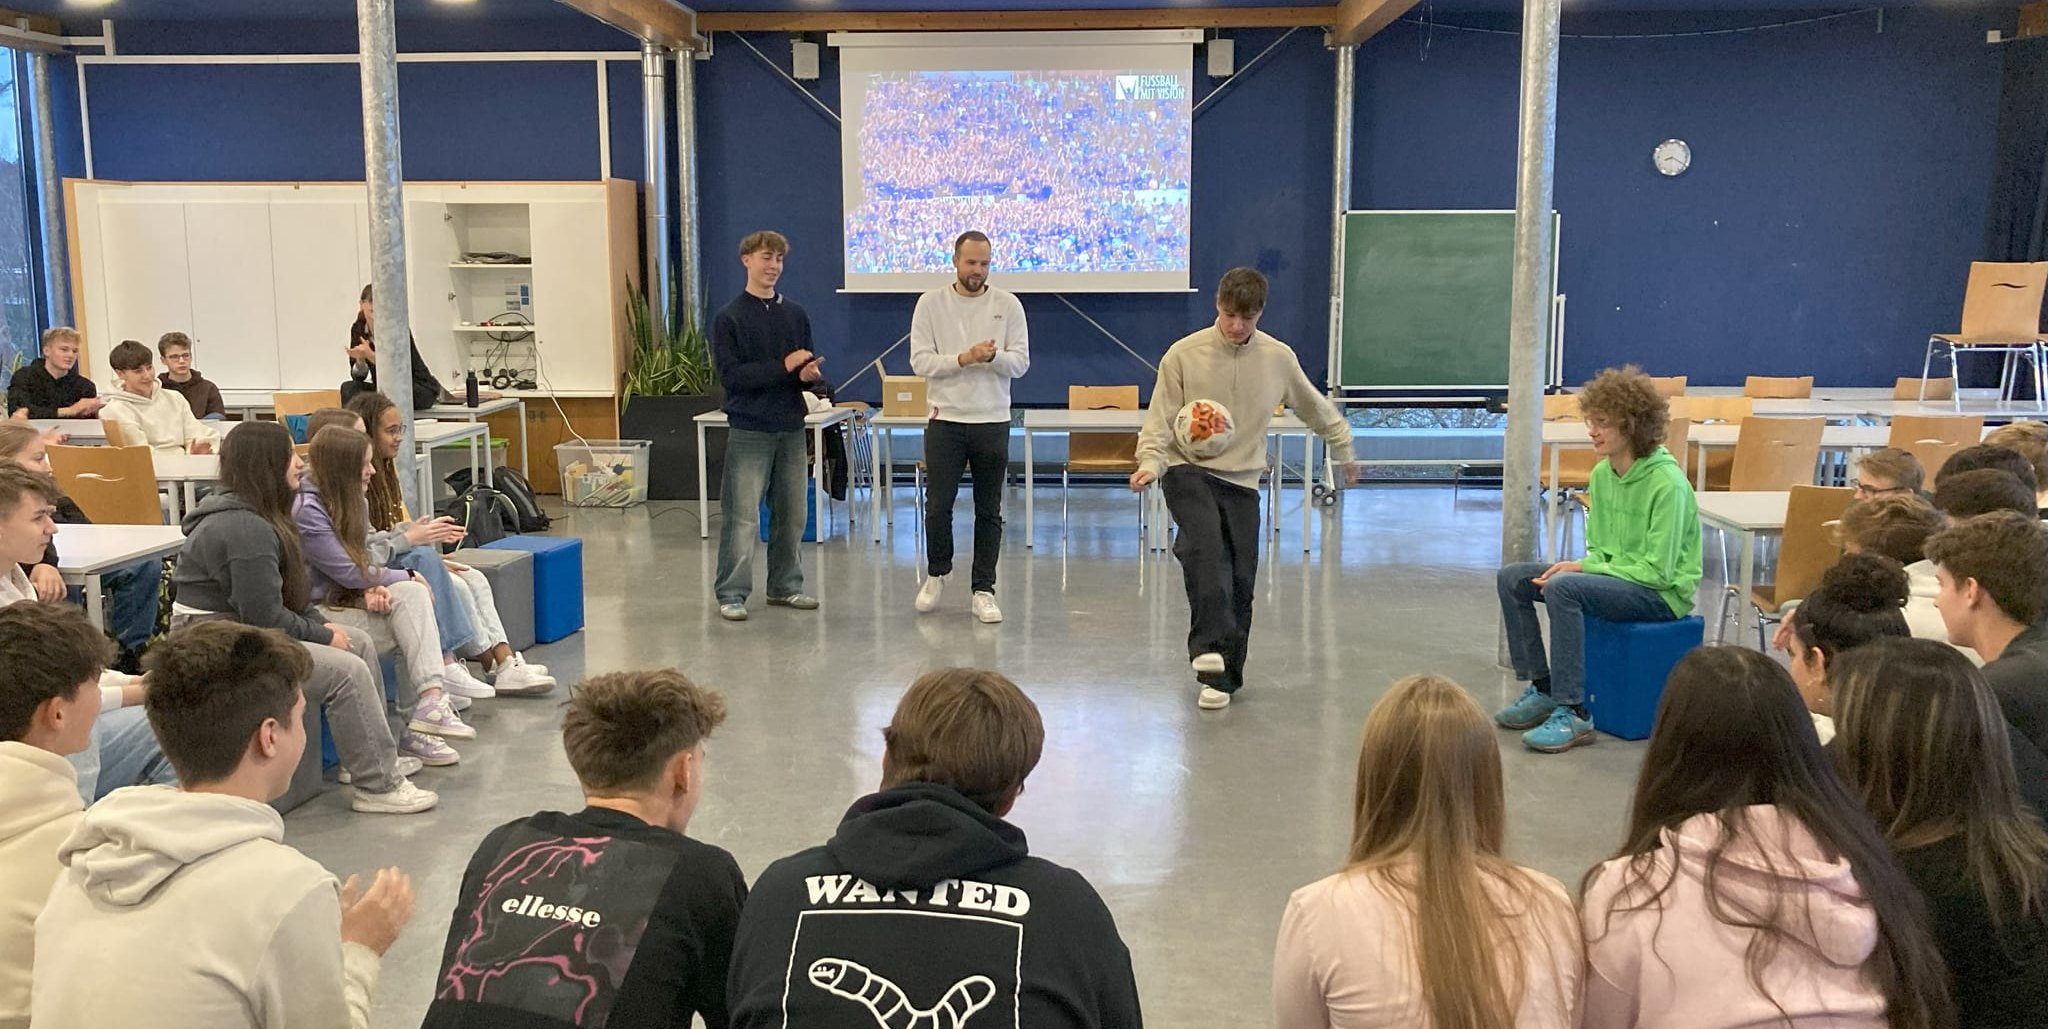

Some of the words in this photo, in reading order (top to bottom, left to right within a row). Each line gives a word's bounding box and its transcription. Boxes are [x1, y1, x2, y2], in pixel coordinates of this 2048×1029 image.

[1140, 75, 1179, 87] FUSSBALL
[1140, 88, 1156, 100] MIT
[1157, 87, 1185, 100] VISION
[501, 894, 601, 928] ellesse
